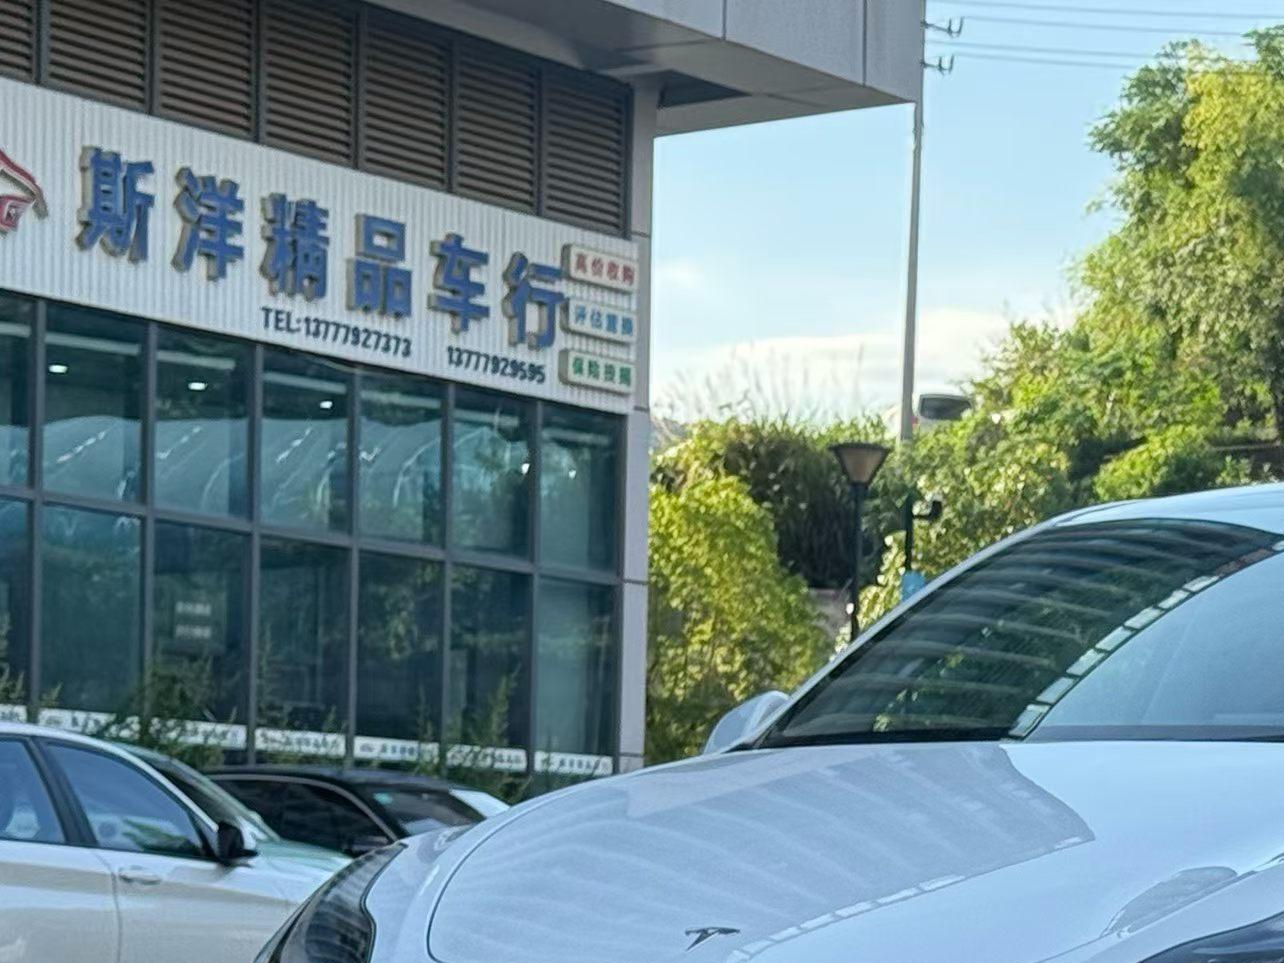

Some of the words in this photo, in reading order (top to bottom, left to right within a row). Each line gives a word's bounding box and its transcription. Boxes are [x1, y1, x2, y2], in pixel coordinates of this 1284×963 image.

[77, 146, 567, 349] 斯洋精品车行
